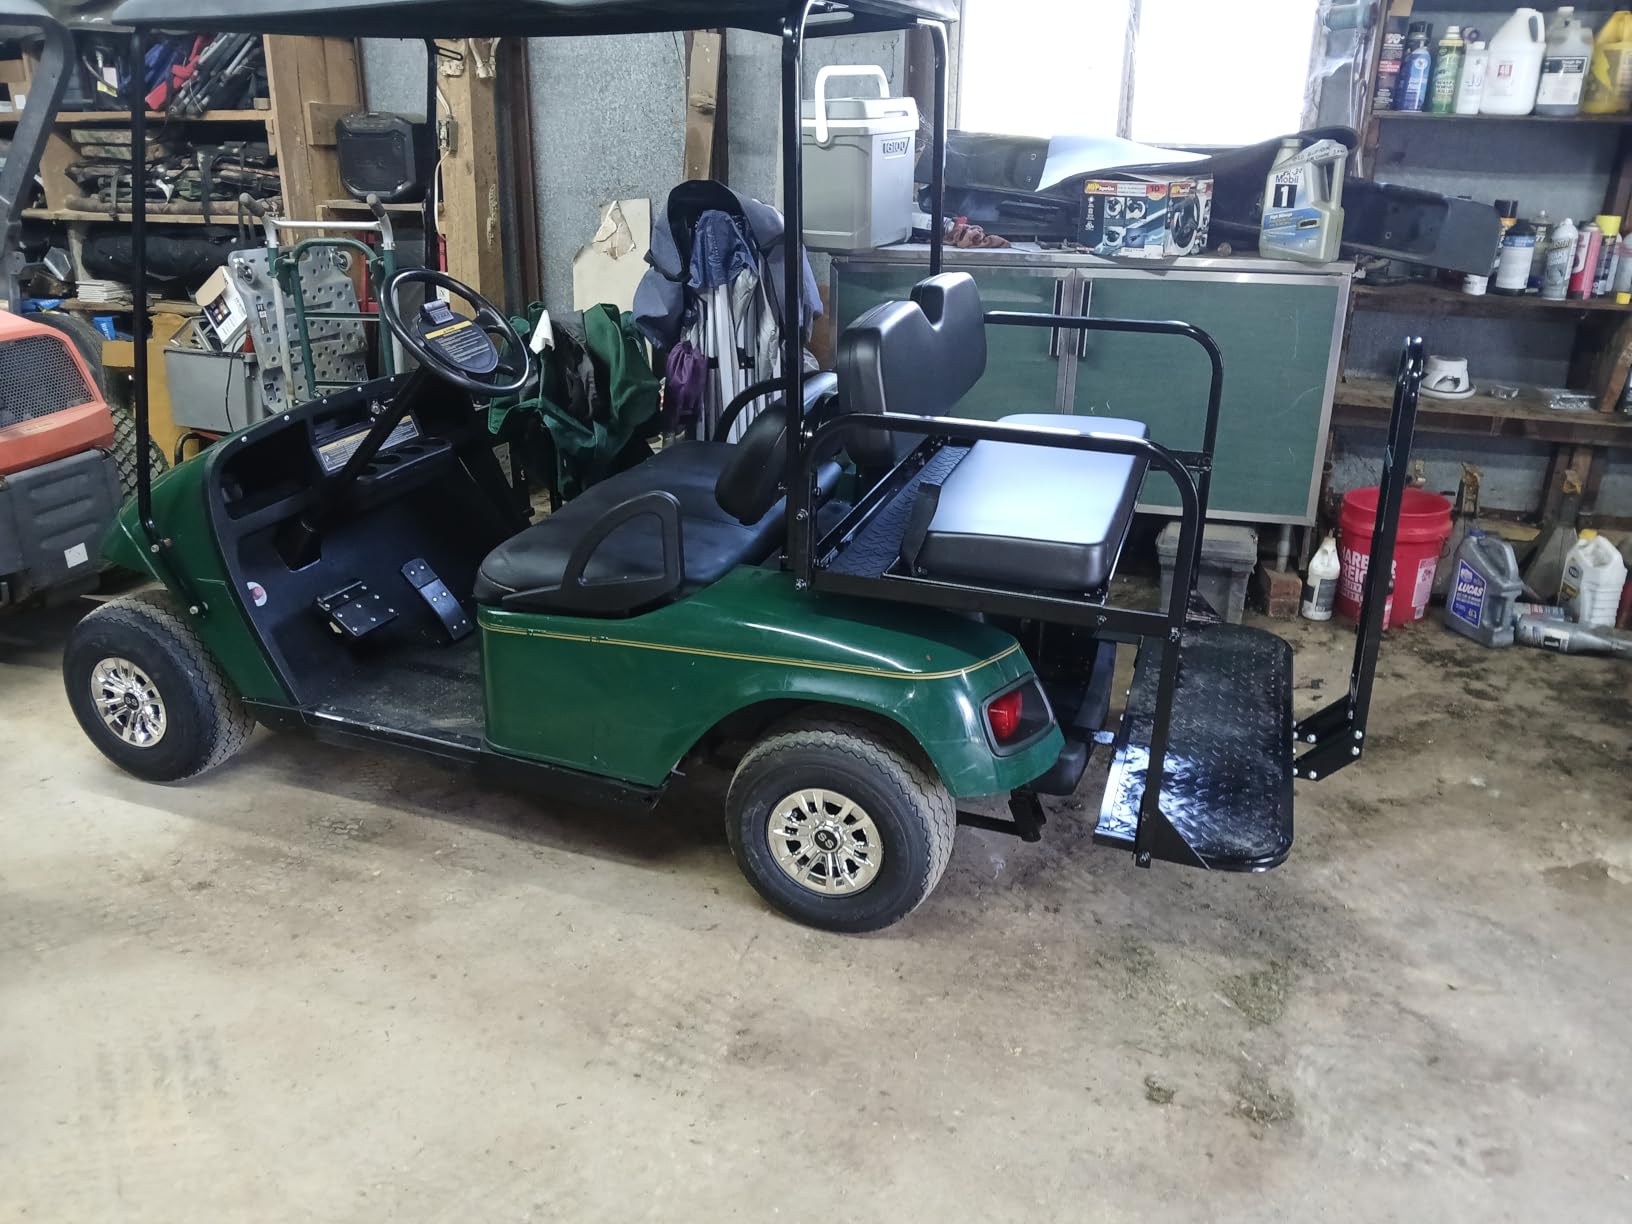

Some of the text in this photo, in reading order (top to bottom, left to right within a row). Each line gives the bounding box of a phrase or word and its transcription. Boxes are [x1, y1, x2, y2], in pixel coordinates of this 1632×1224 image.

[1275, 174, 1299, 184] Mobil
[1280, 185, 1289, 207] 1
[1458, 582, 1484, 597] LUCAS
[817, 832, 834, 849] SS
